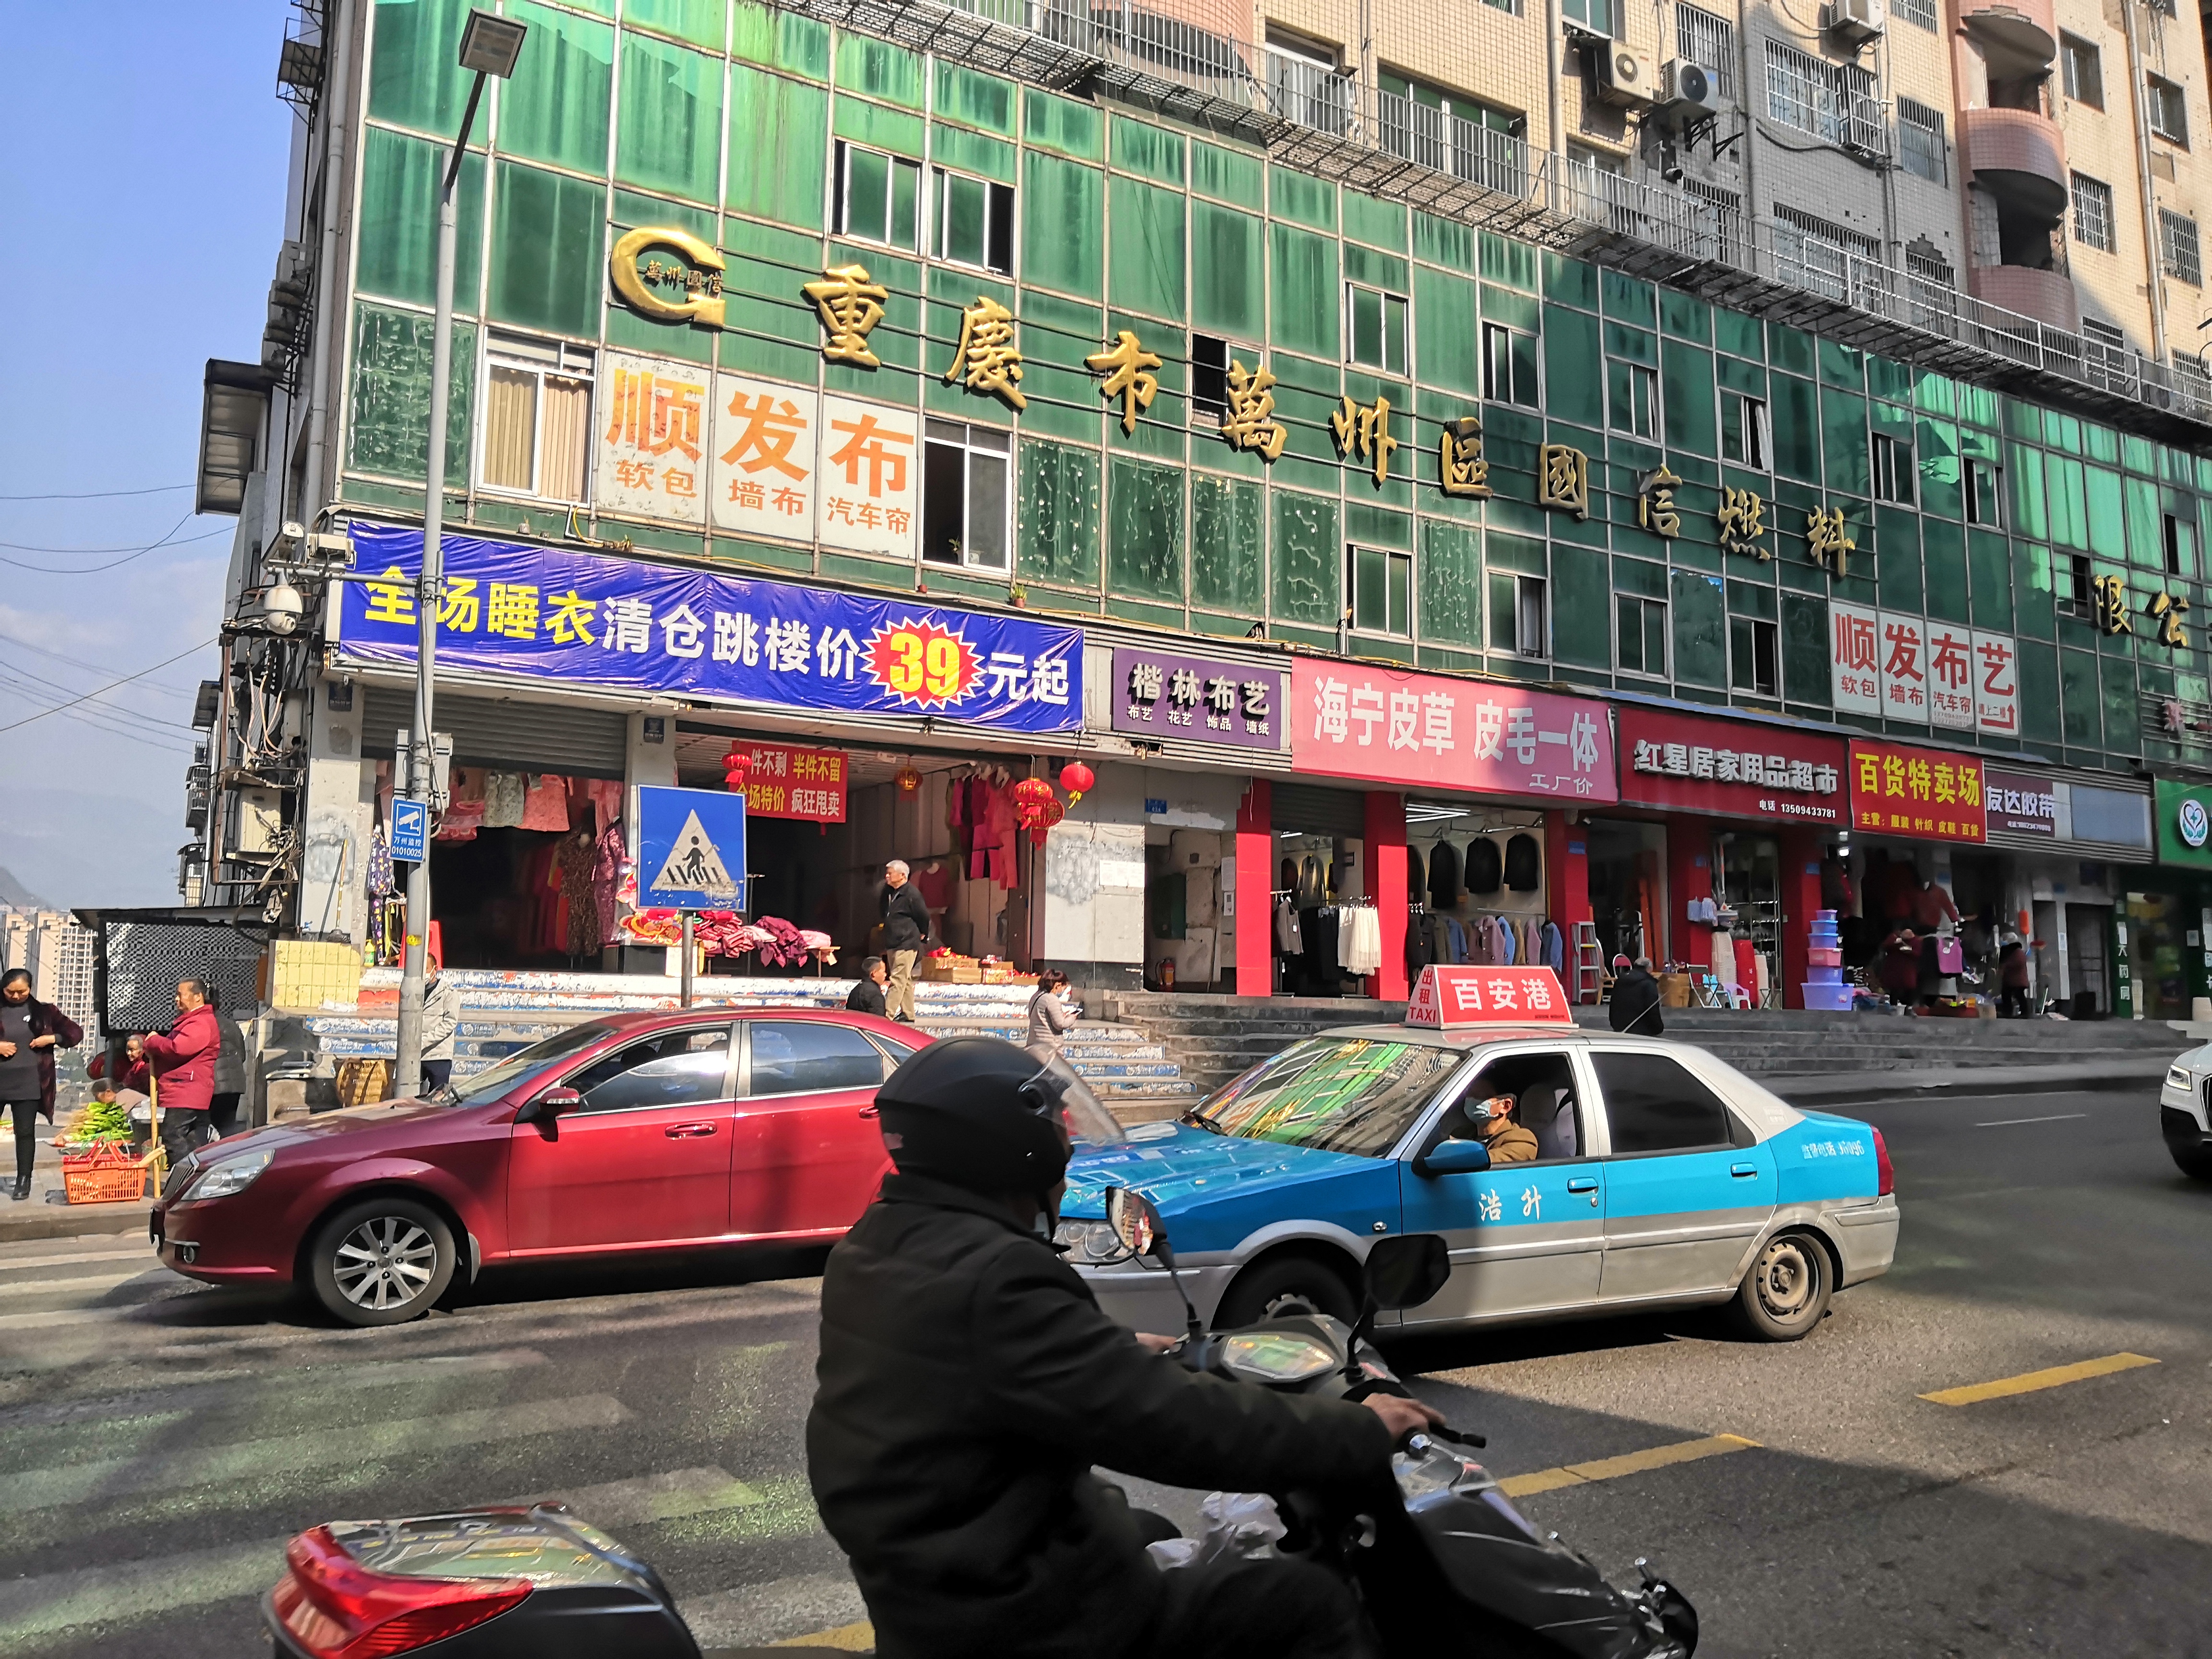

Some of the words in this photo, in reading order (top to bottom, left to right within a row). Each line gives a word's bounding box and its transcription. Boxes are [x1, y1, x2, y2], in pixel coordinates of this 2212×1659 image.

[606, 369, 914, 498] 顺发布
[615, 459, 697, 498] 软包
[728, 479, 807, 516] 墙布
[827, 496, 911, 535] 汽车帘
[1834, 613, 2015, 697] 顺发布艺
[1131, 661, 1271, 716] 楷林布艺
[1841, 674, 1877, 698] 软包
[1889, 684, 1924, 707] 墙布
[1933, 690, 1972, 714] 汽车帘
[1127, 704, 1153, 721] 布艺
[1168, 709, 1193, 726] 花艺
[1206, 715, 1232, 732] 饰品
[1245, 720, 1270, 736] 墙纸
[1313, 675, 1455, 756] 海宁皮草
[1474, 699, 1599, 772] 皮毛一体
[750, 748, 788, 778] 件不剩
[793, 753, 841, 783] 半件不留
[1634, 739, 1839, 794] 红星居家用品超市
[1855, 753, 1980, 807] 百货特卖场
[1528, 773, 1593, 795] 工厂价
[791, 787, 840, 817] 疯狂甩卖
[1759, 799, 1776, 811] 电话
[1780, 803, 1836, 818] 13509433781
[391, 845, 422, 857] 01010025
[394, 836, 422, 847] 万州监控
[1418, 969, 1433, 1005] 出租
[1450, 978, 1551, 1011] 百安港
[1409, 1006, 1436, 1023] TAXI
